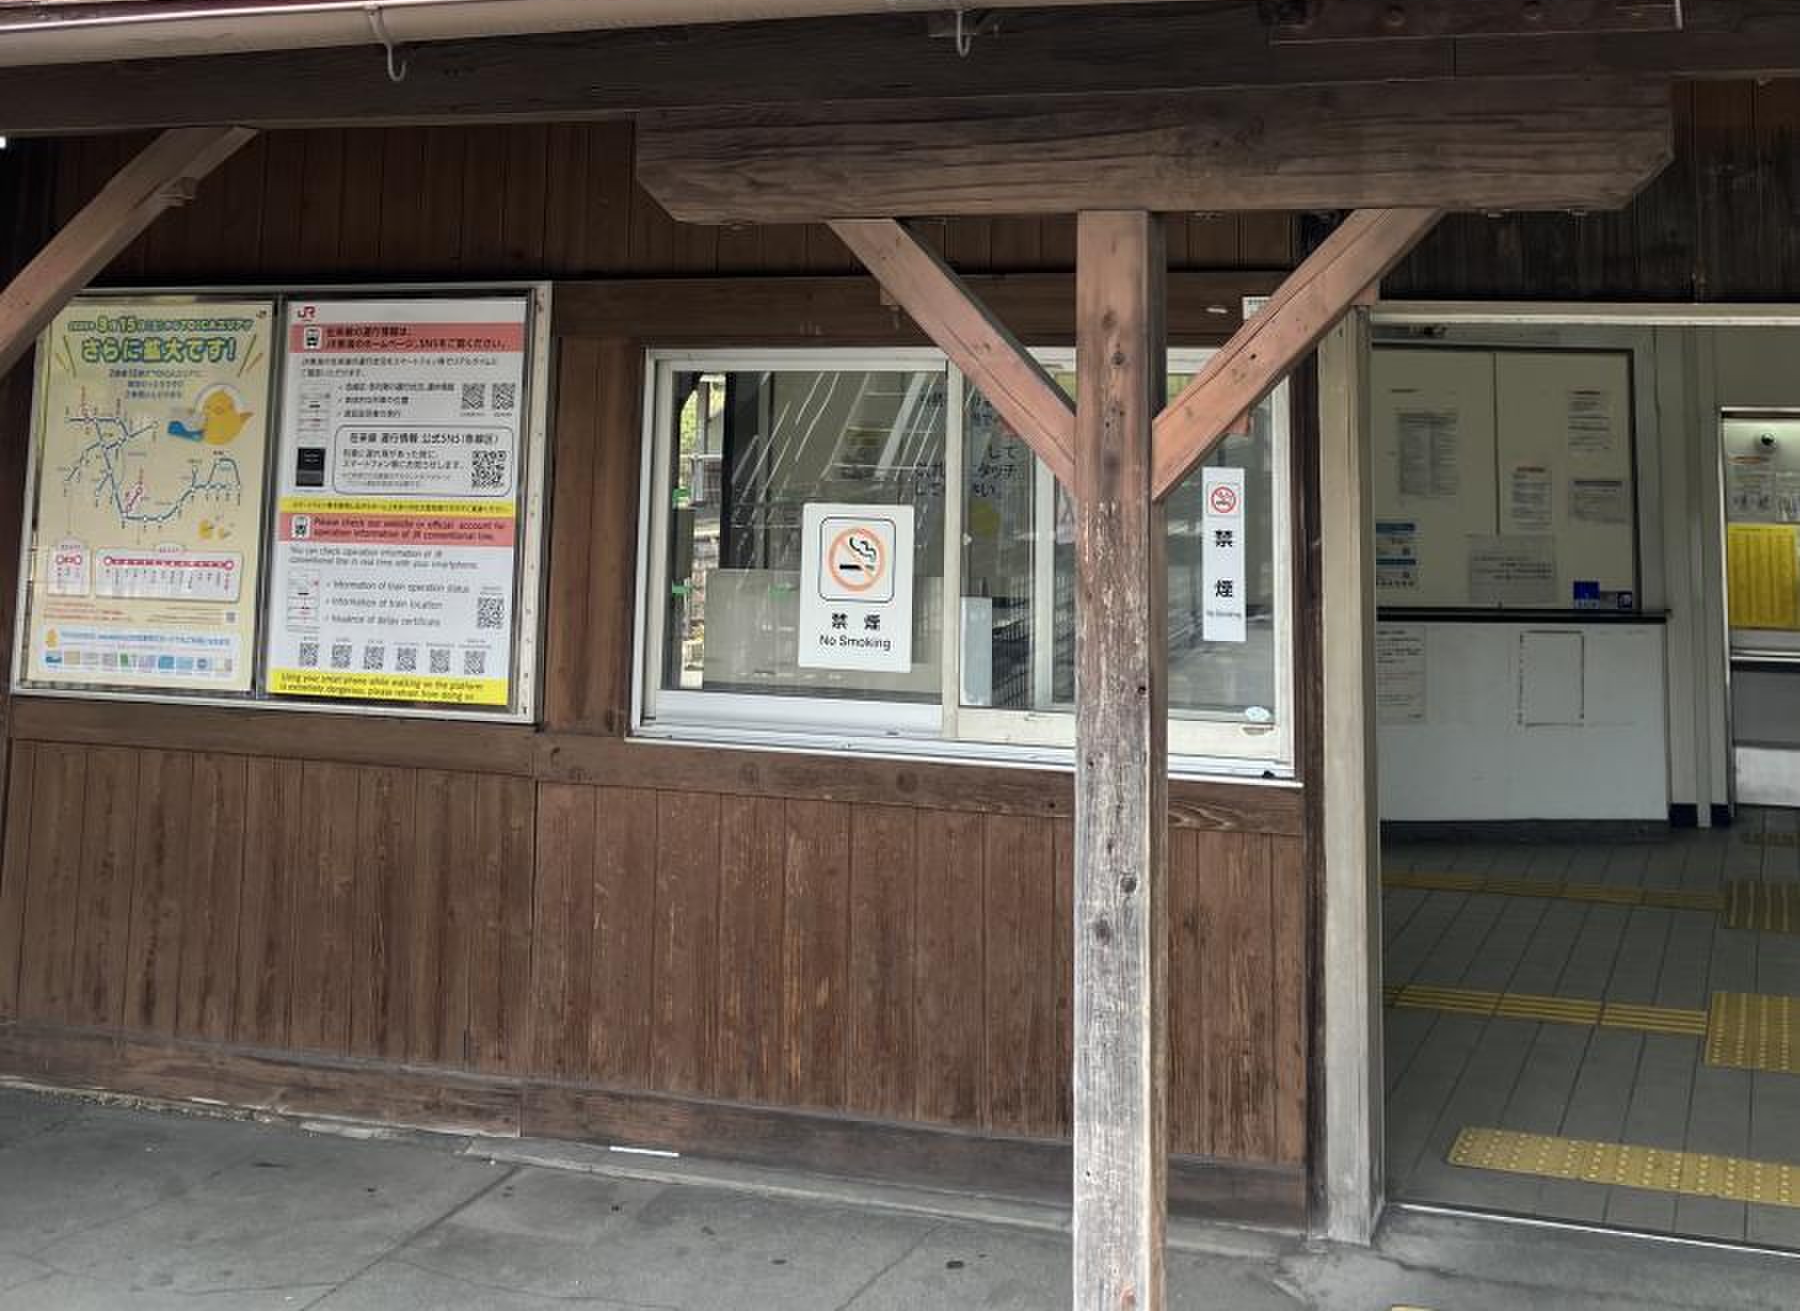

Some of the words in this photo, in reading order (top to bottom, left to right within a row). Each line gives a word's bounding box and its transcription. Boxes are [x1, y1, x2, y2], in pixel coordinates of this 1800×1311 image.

[297, 306, 316, 318] JR
[1215, 530, 1233, 598] 禁煙
[832, 613, 880, 631] 禁煙
[820, 635, 836, 647] No
[839, 635, 891, 652] Smoking
